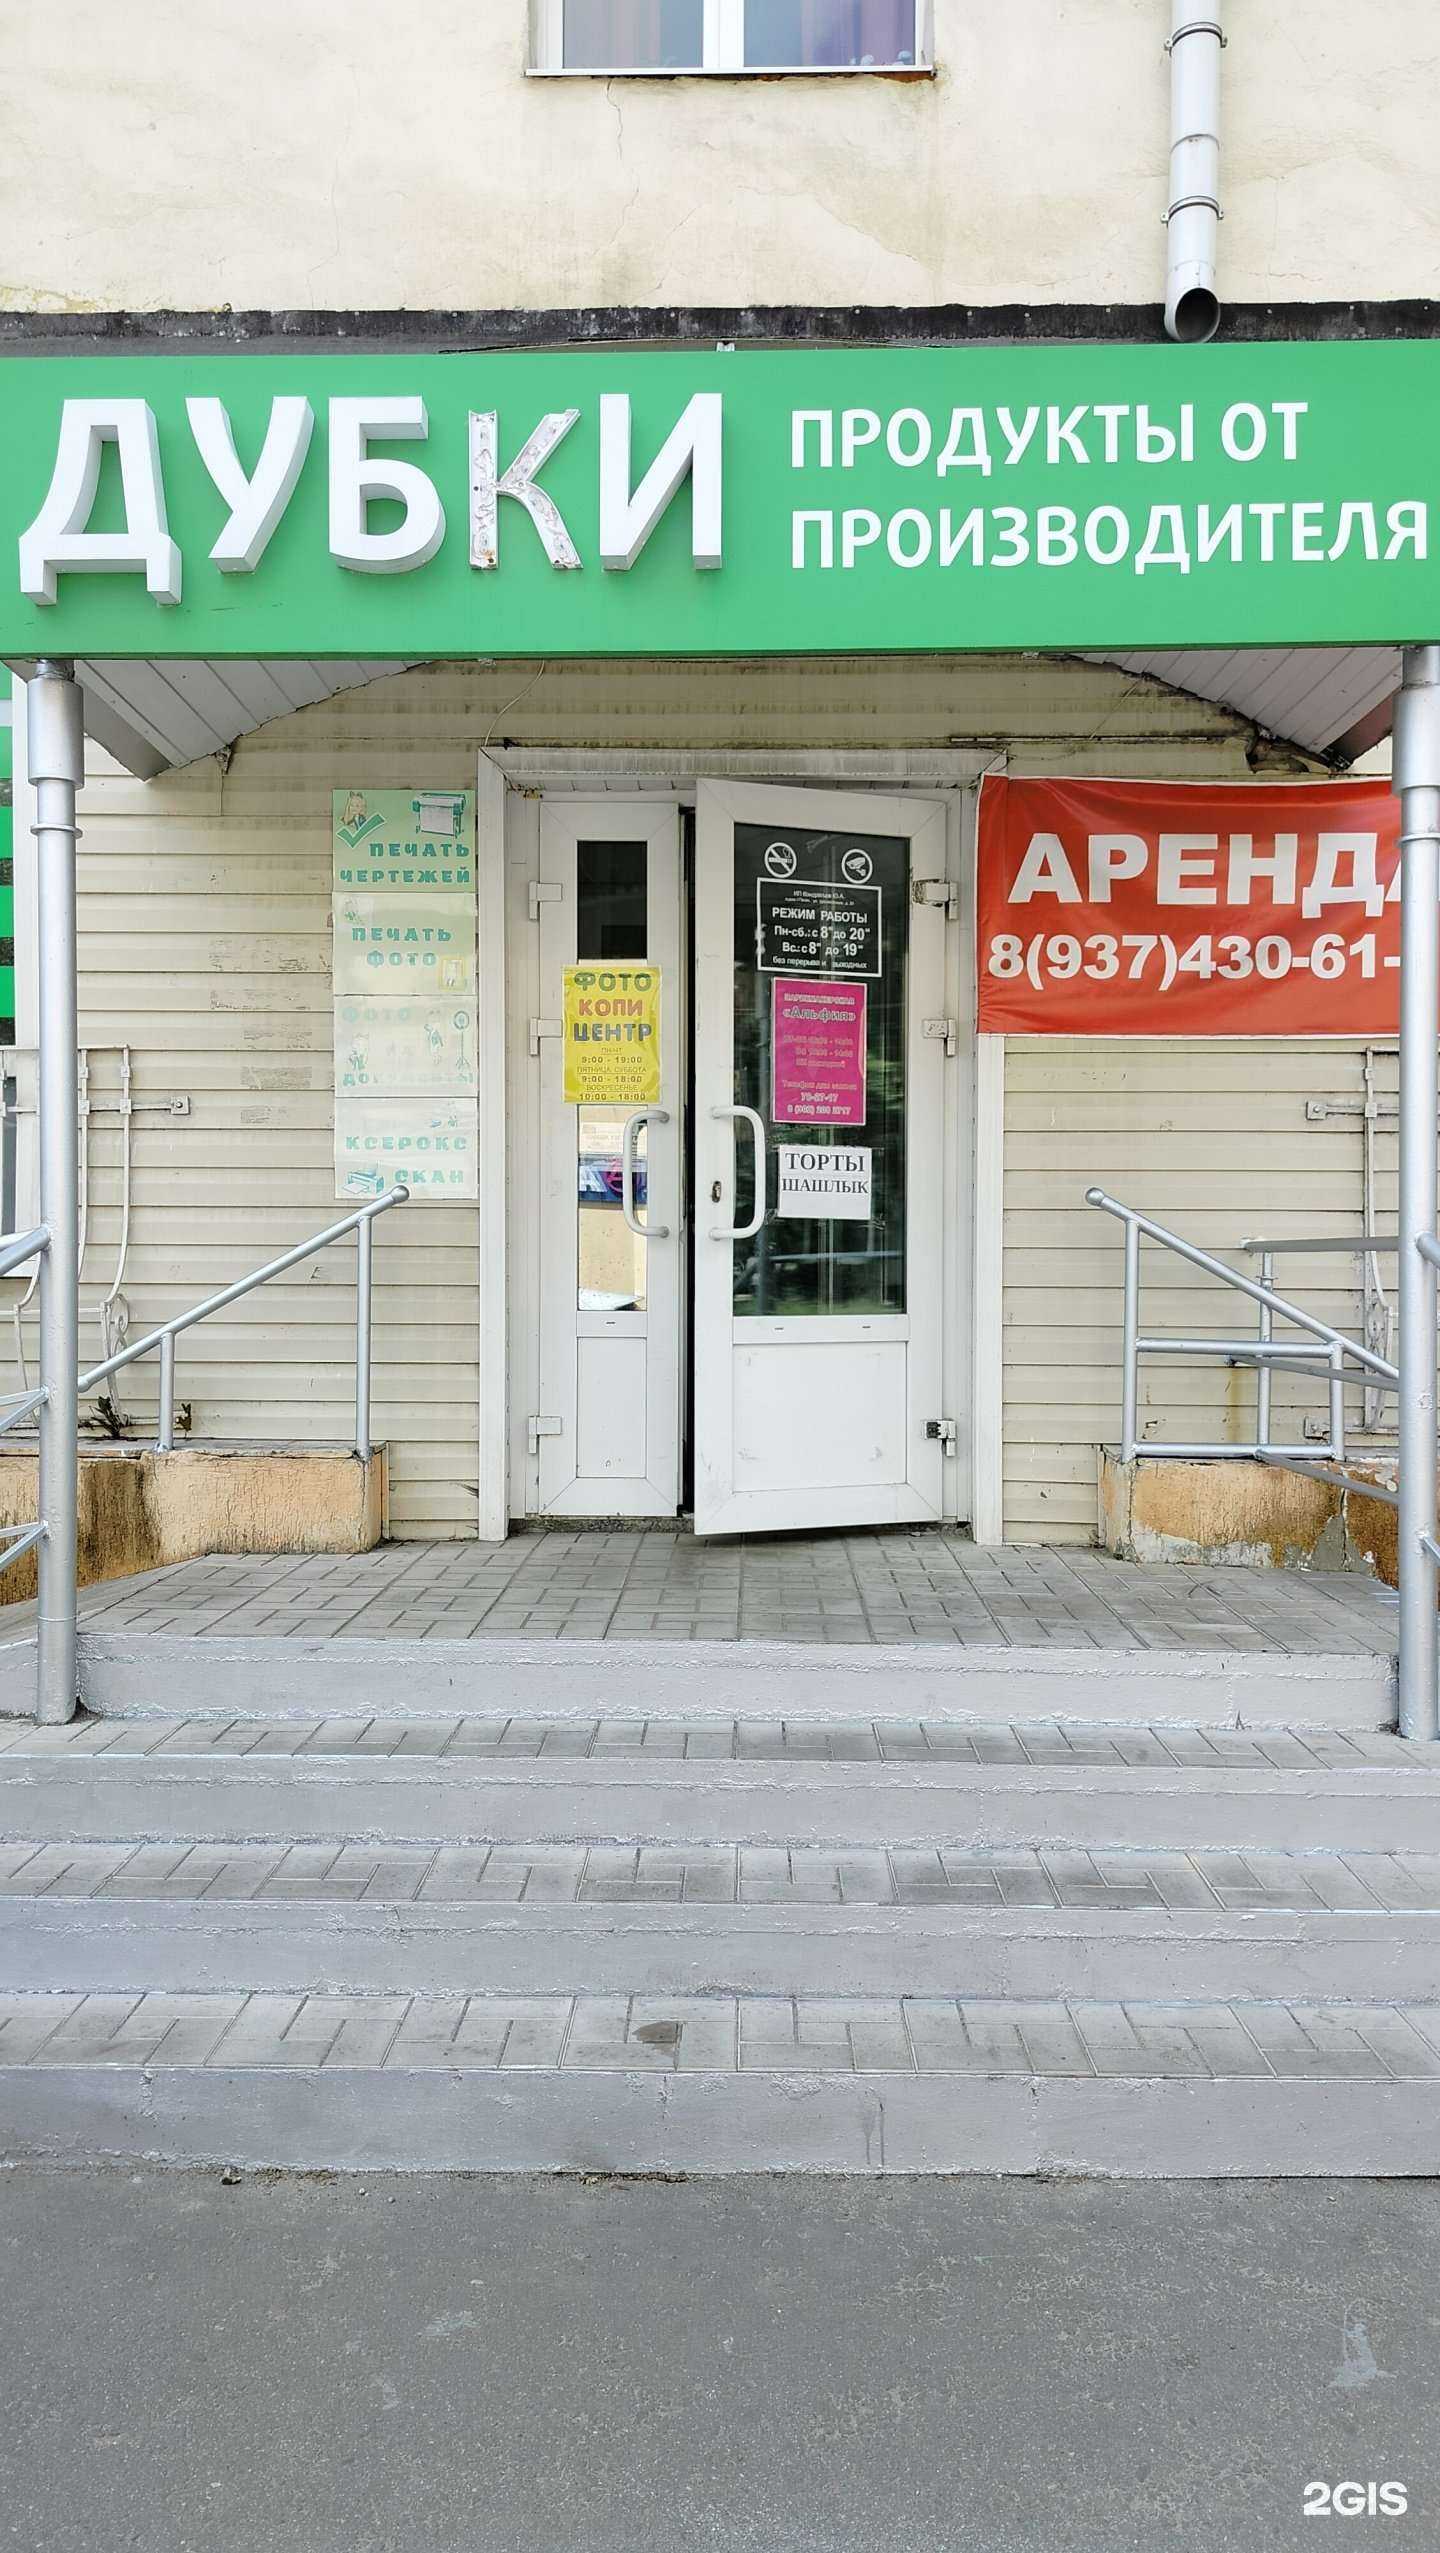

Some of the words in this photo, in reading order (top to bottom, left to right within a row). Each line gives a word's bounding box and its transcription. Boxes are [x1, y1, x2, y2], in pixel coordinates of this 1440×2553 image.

[790, 404, 1195, 477] ПРОДУКТЫ
[1220, 402, 1309, 462] ОТ
[19, 393, 723, 606] ДУБКИ
[790, 500, 1428, 575] ПРОИЗВОДИТЕЛЯ
[369, 842, 470, 858] ПЕЧАТЬ
[339, 867, 470, 884] ЧЕРТЕЖЕЙ
[772, 907, 816, 920] РЕЖИМ
[820, 910, 868, 924] РАБОТЫ
[351, 927, 452, 942] ПЕЧАТЬ
[833, 930, 847, 941] до
[366, 949, 437, 967] ФОТО
[825, 946, 839, 956] до
[772, 956, 786, 964] без
[988, 933, 1401, 991] 8(937)430-61-
[574, 972, 652, 992] ФОТО
[578, 998, 643, 1017] КОПИ
[573, 1022, 652, 1042] ЦЕНТР
[615, 1056, 643, 1064] 19:00
[579, 1093, 607, 1101] 10:00
[618, 1093, 646, 1101] 18:00
[345, 1135, 468, 1151] КСЕРОКС
[785, 1153, 865, 1172] ТОРТЫ
[393, 1169, 465, 1184] СКАН
[782, 1178, 869, 1194] ШАШЛЫК
